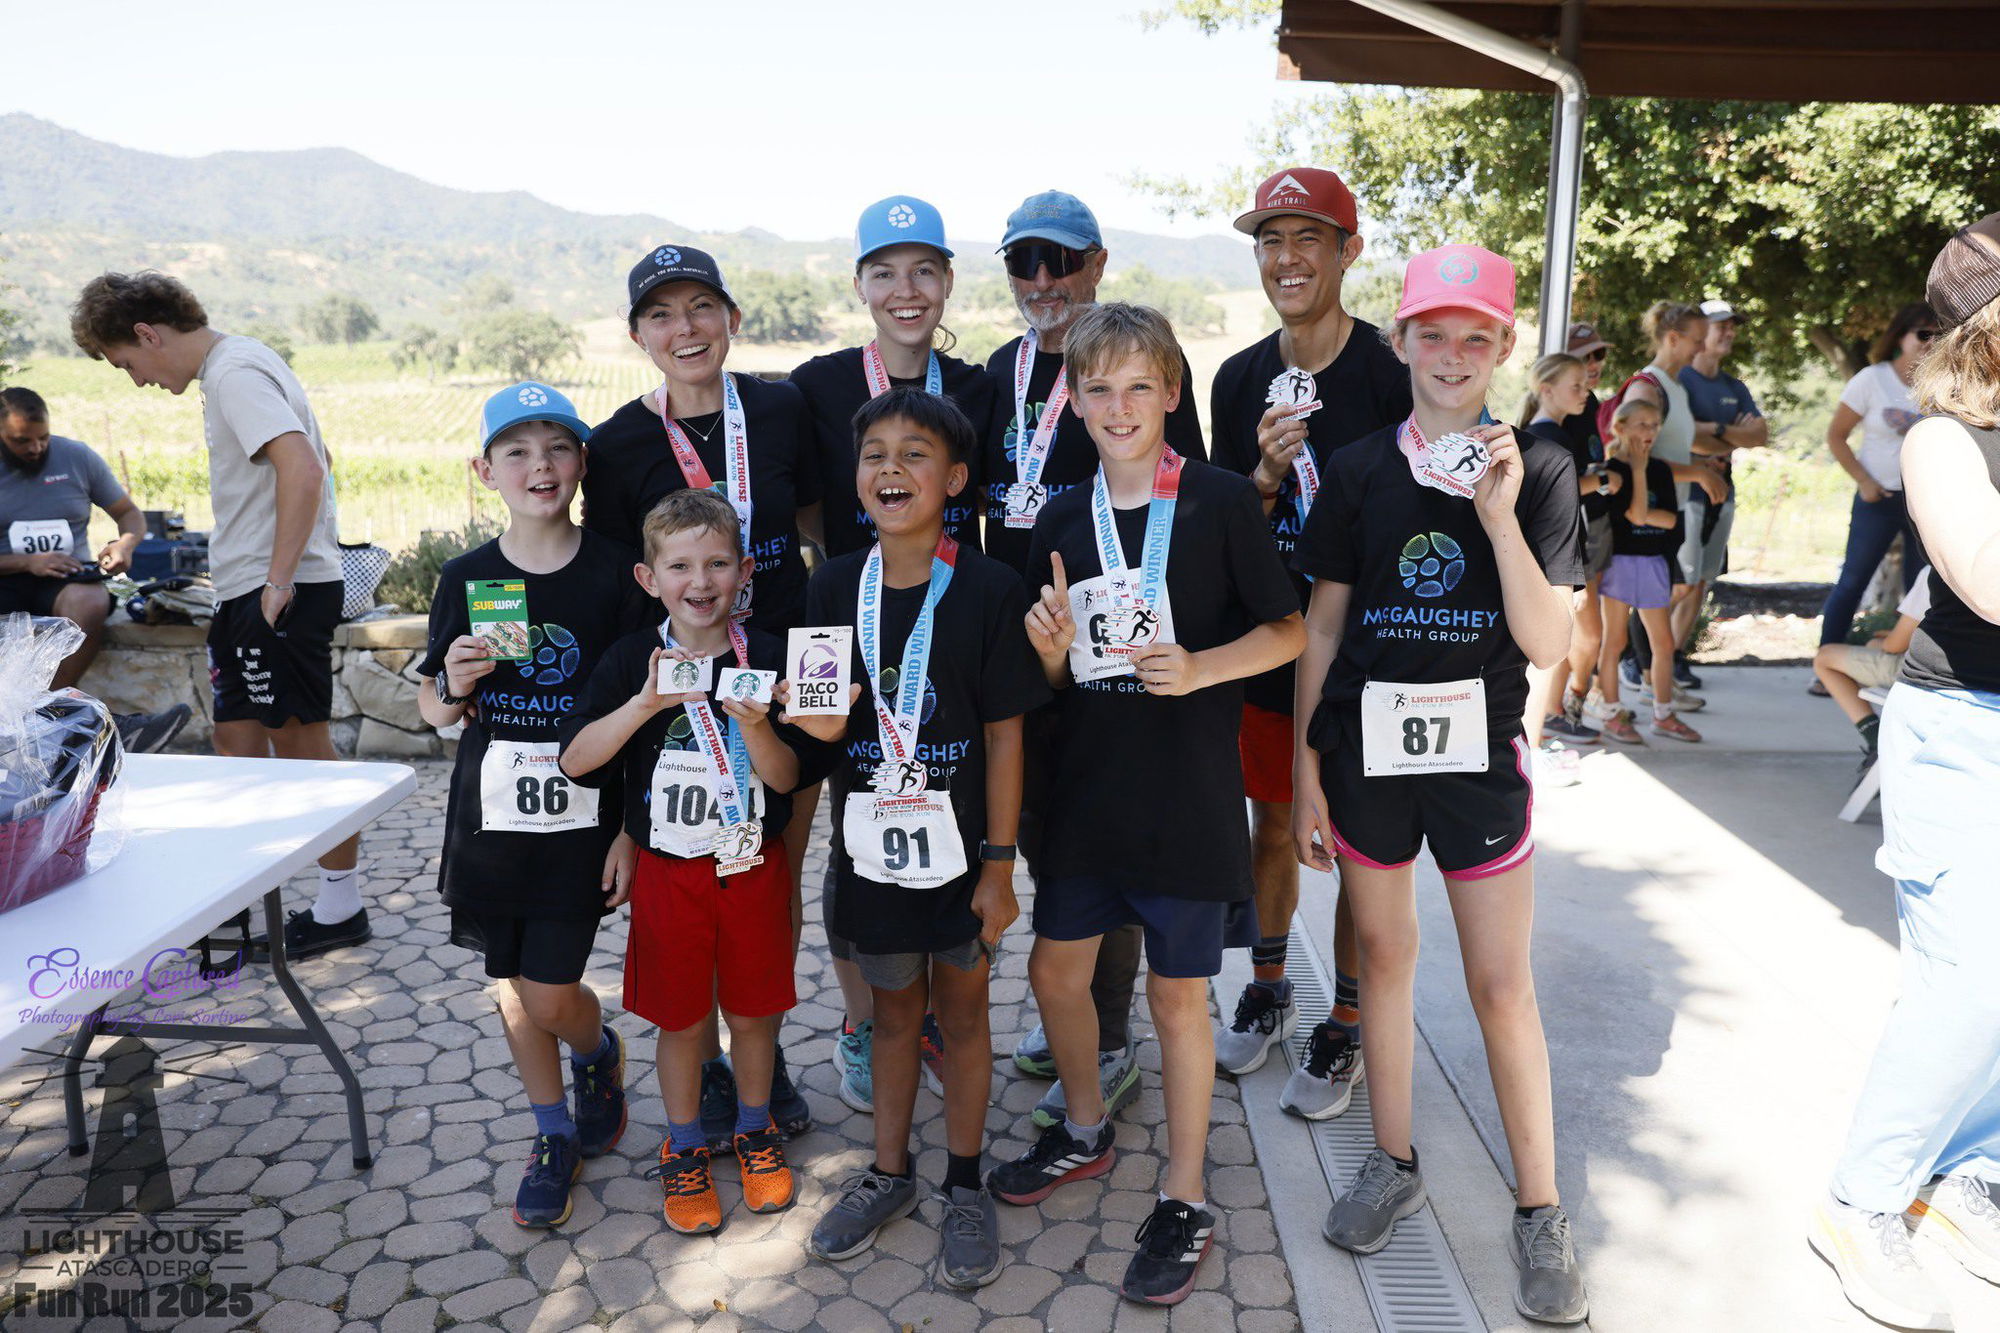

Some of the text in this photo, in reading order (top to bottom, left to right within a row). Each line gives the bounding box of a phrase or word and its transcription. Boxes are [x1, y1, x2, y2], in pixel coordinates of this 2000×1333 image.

[871, 348, 888, 391] LIGHTHO
[1017, 340, 1030, 392] LIGHTHOUSE
[736, 436, 748, 502] LIGHTHOUSE
[1304, 462, 1317, 498] LIGHT
[1423, 469, 1474, 497] LIGHTHOUSE
[23, 534, 64, 554] 302
[1097, 508, 1120, 570] WINNER
[1146, 518, 1166, 584] WINNER
[754, 559, 781, 572] OUP
[863, 556, 880, 606] AWARD
[472, 600, 522, 611] SUBWAY
[862, 609, 875, 678] WINNER
[1376, 628, 1480, 643] HEALTH GROUP
[902, 601, 928, 717] AWARD WINN
[1105, 647, 1134, 655] LIGHT
[797, 682, 838, 695] TACO
[1118, 682, 1146, 693] GRO
[1410, 692, 1472, 704] LIGHTHOUSE
[480, 688, 574, 711] McGAUG
[799, 695, 837, 708] BELL
[492, 713, 546, 727] HEALTH
[695, 719, 705, 737] FUN
[701, 739, 712, 757] RUN
[697, 705, 729, 776] LIGHTHOUSE
[1402, 717, 1450, 756] 87
[847, 740, 970, 762] McGGHEY
[658, 761, 707, 774] Lighthouse
[930, 766, 957, 777] OUP
[516, 776, 568, 815] 86
[878, 797, 927, 806] LIGHTHOUSE
[509, 819, 542, 827] Lighthouse
[883, 827, 930, 870] 91
[718, 856, 763, 872] LIGHTHOUSE
